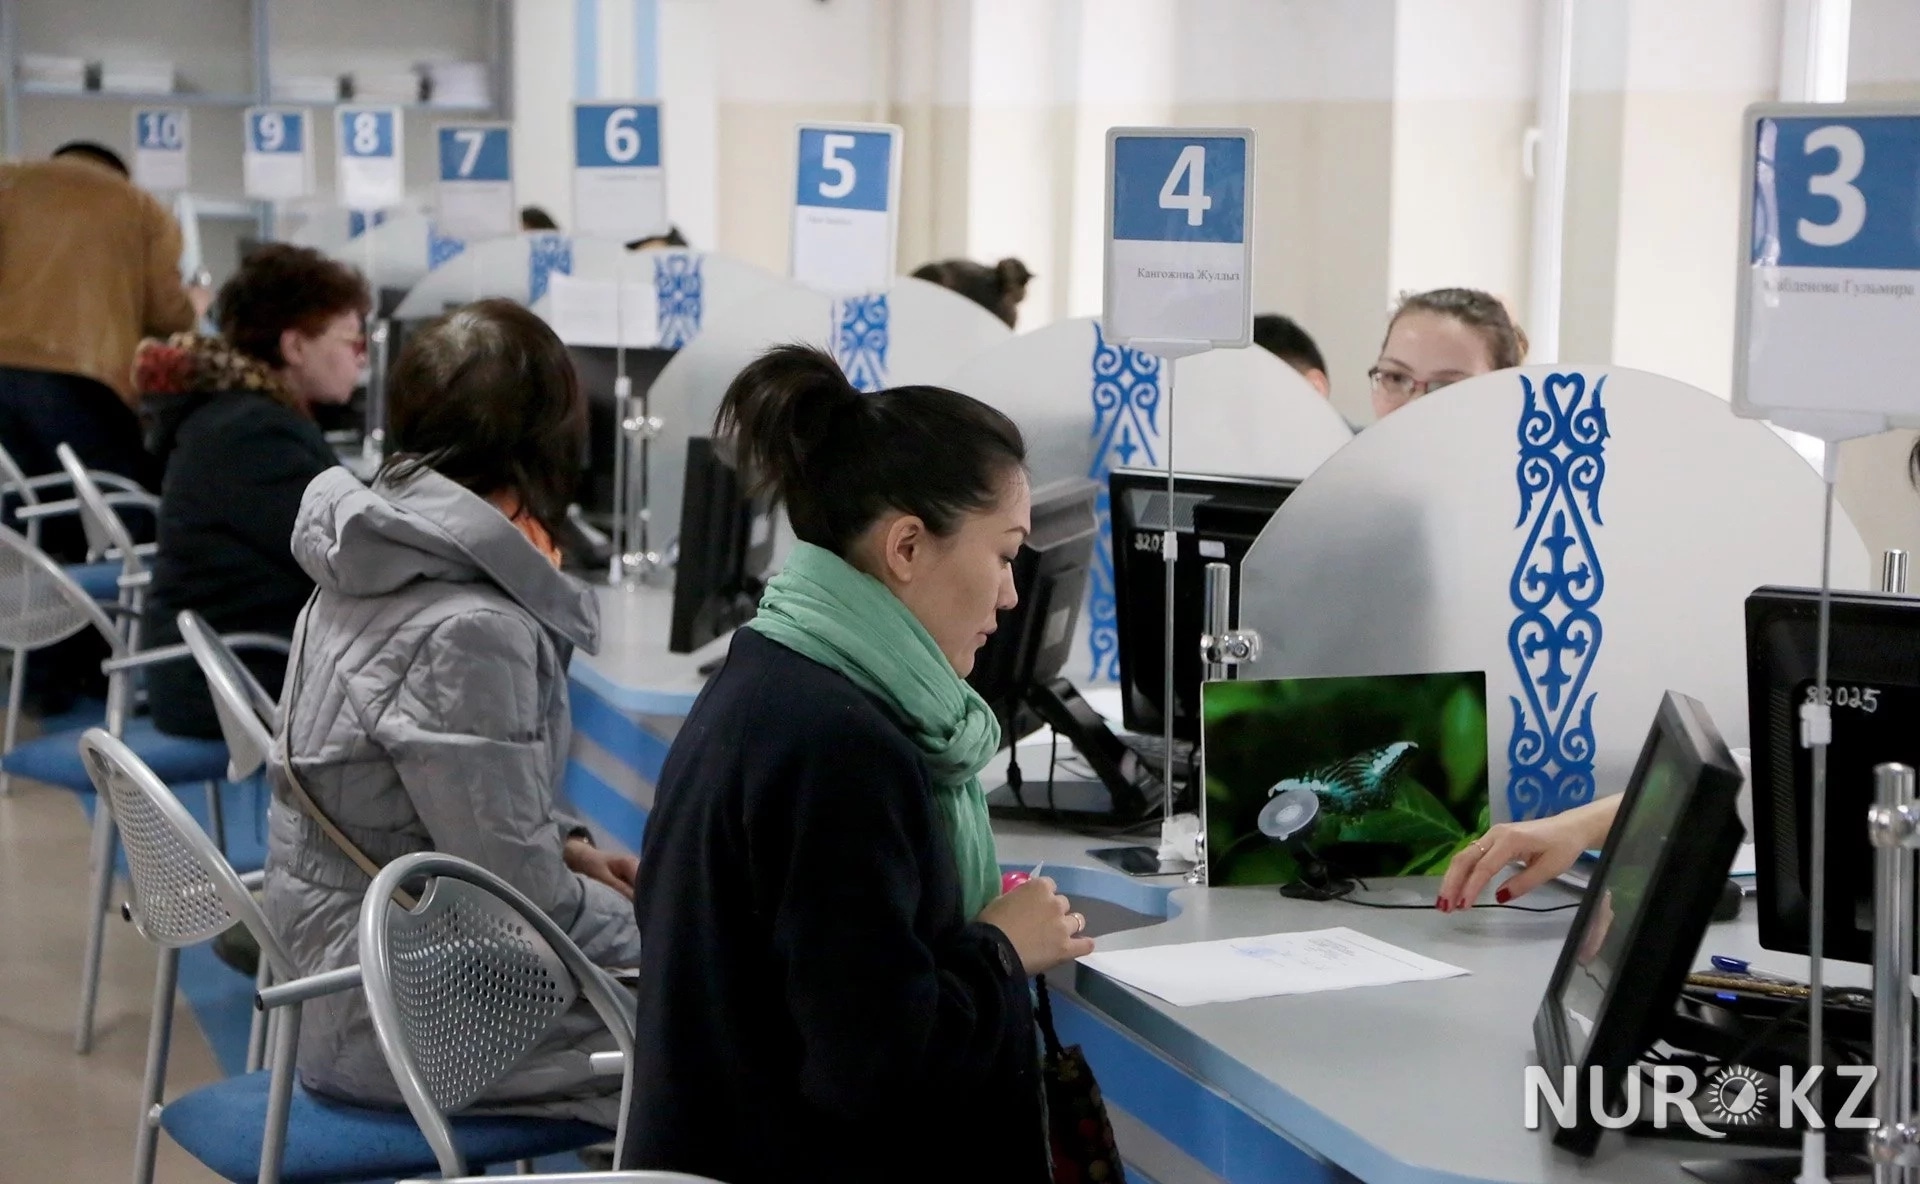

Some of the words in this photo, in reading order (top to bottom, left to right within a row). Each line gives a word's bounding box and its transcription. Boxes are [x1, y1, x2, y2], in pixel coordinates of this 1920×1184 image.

[145, 113, 181, 148] 10
[259, 112, 285, 150] 9
[354, 112, 379, 153] 8
[454, 130, 486, 177] 7
[604, 108, 641, 163] 6
[818, 134, 857, 199] 5
[1158, 145, 1212, 227] 4
[1796, 125, 1867, 247] 3
